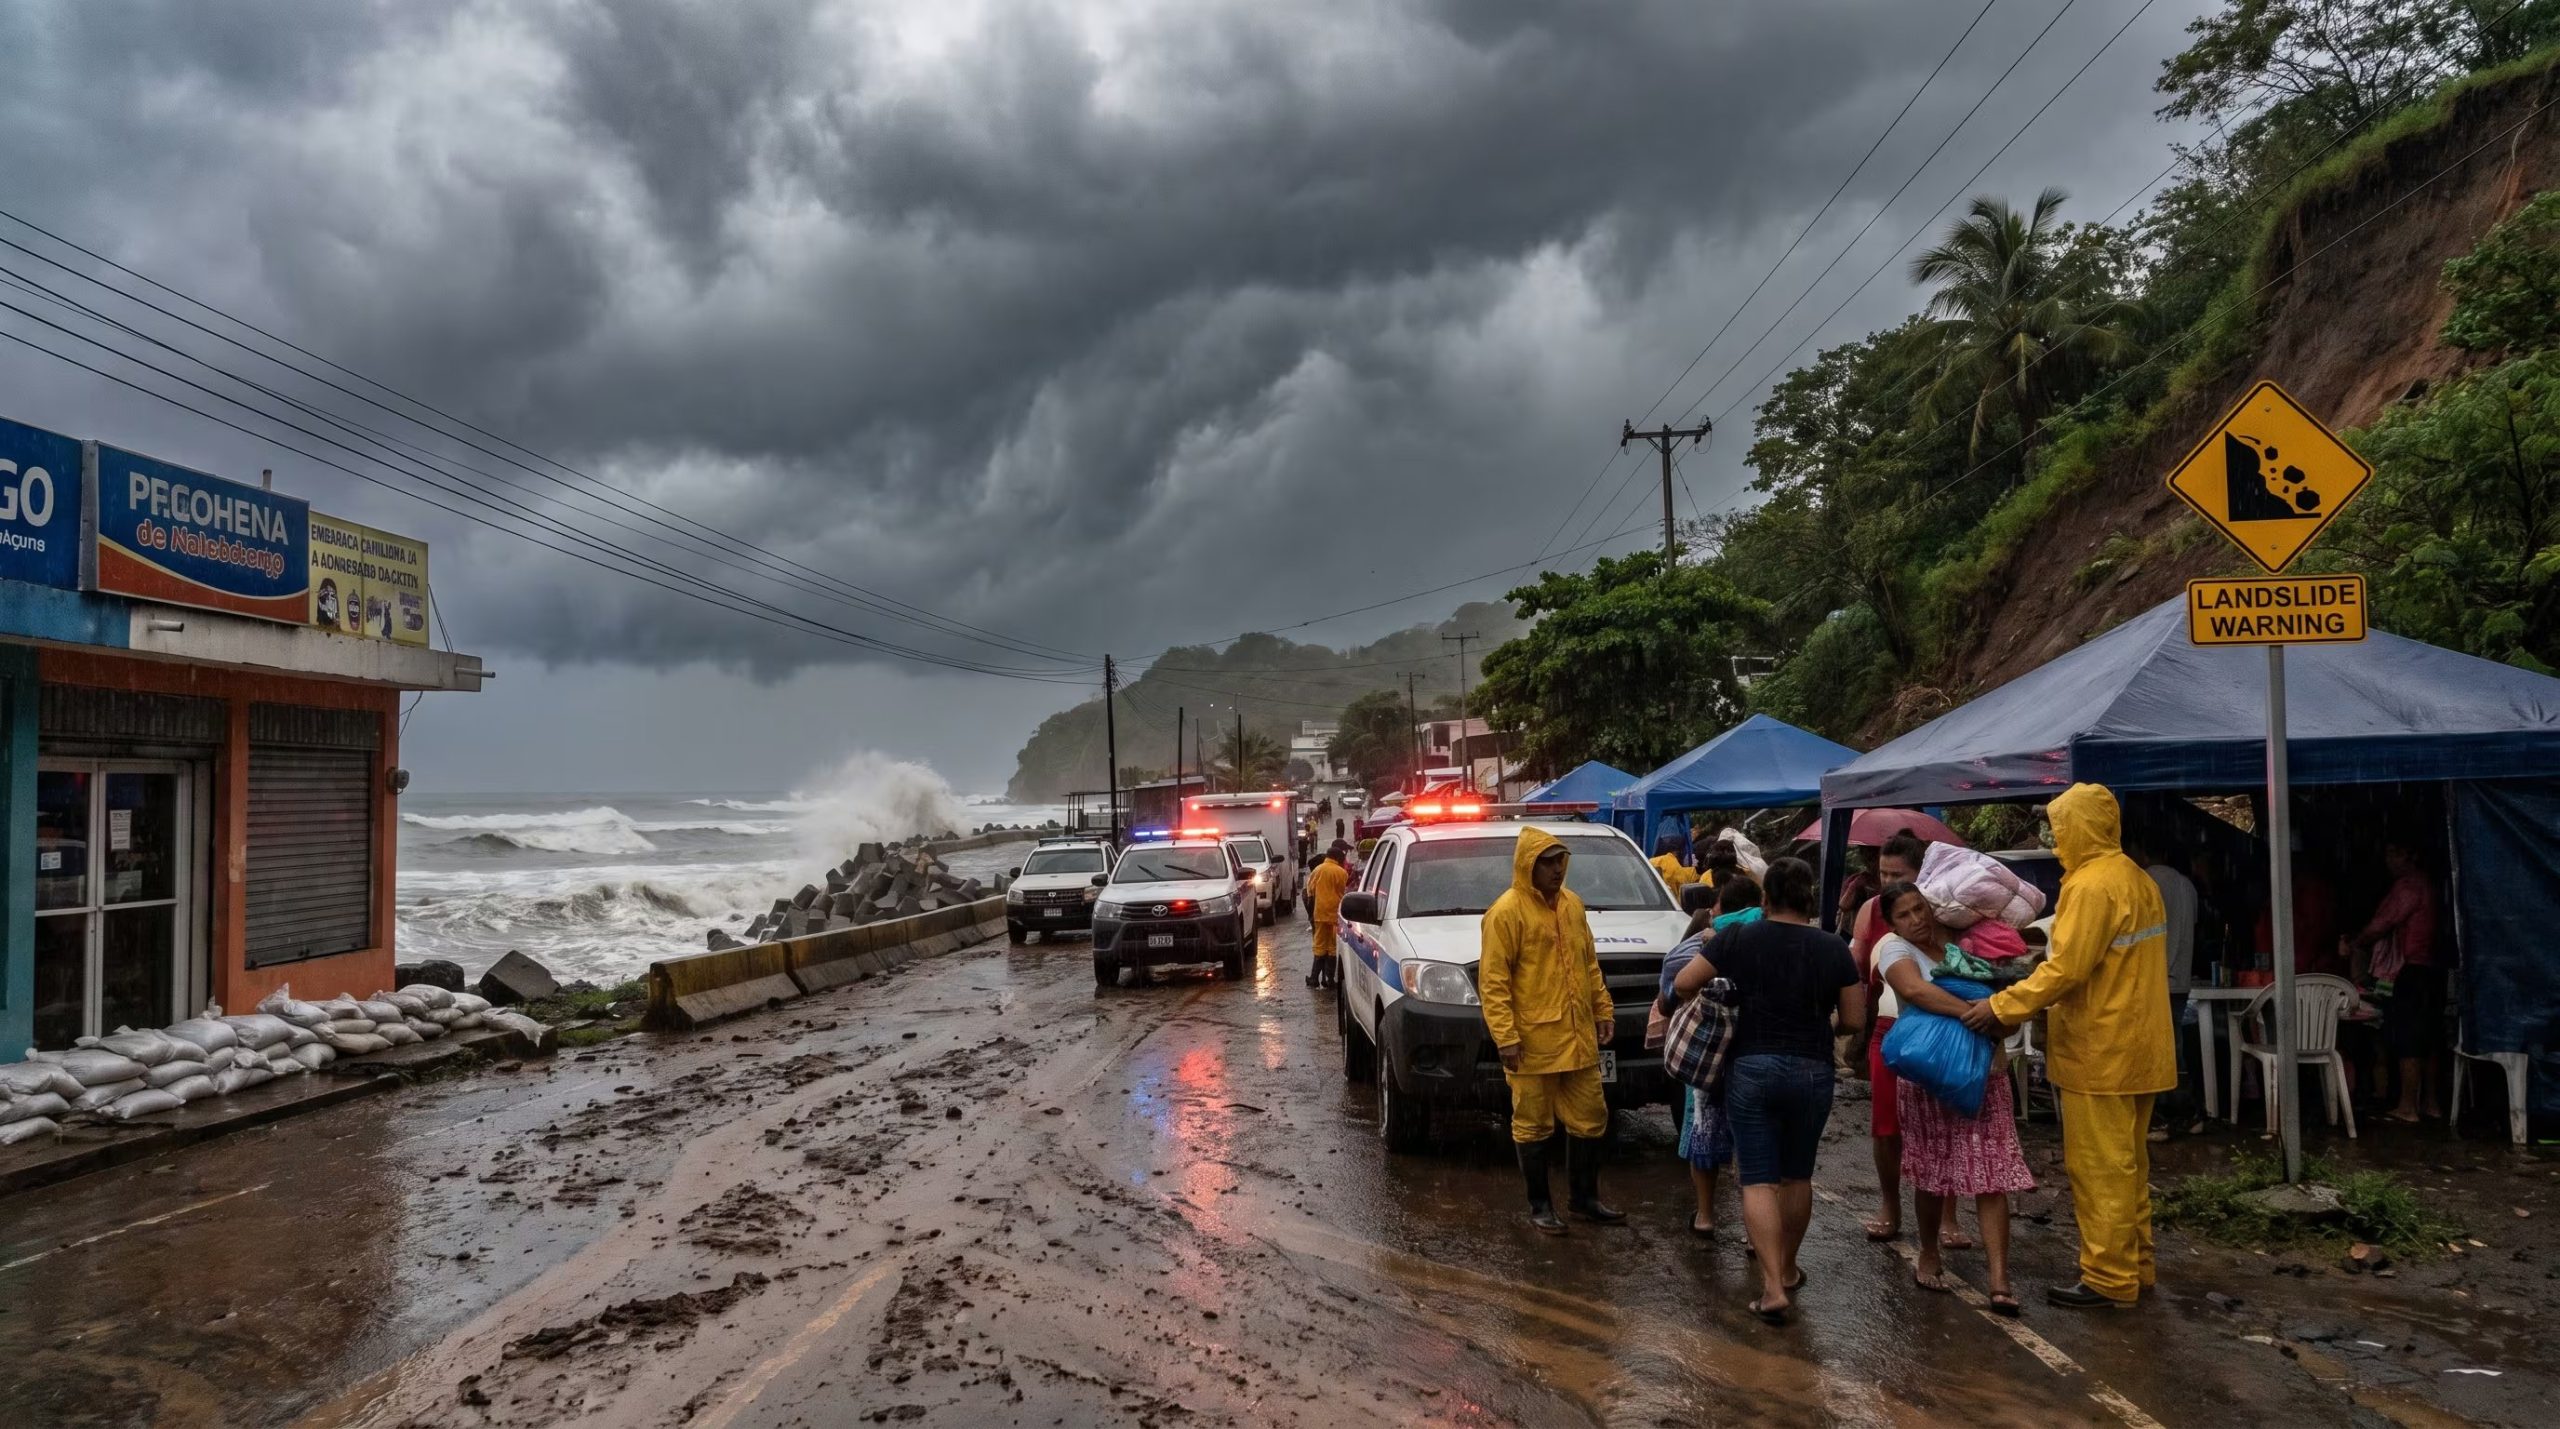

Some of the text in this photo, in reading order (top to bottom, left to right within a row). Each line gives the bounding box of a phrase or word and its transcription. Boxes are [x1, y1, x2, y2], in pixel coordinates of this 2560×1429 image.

[136, 518, 167, 550] de
[311, 550, 319, 567] A
[2198, 584, 2356, 609] LANDSLIDE
[2211, 613, 2345, 637] WARNING
